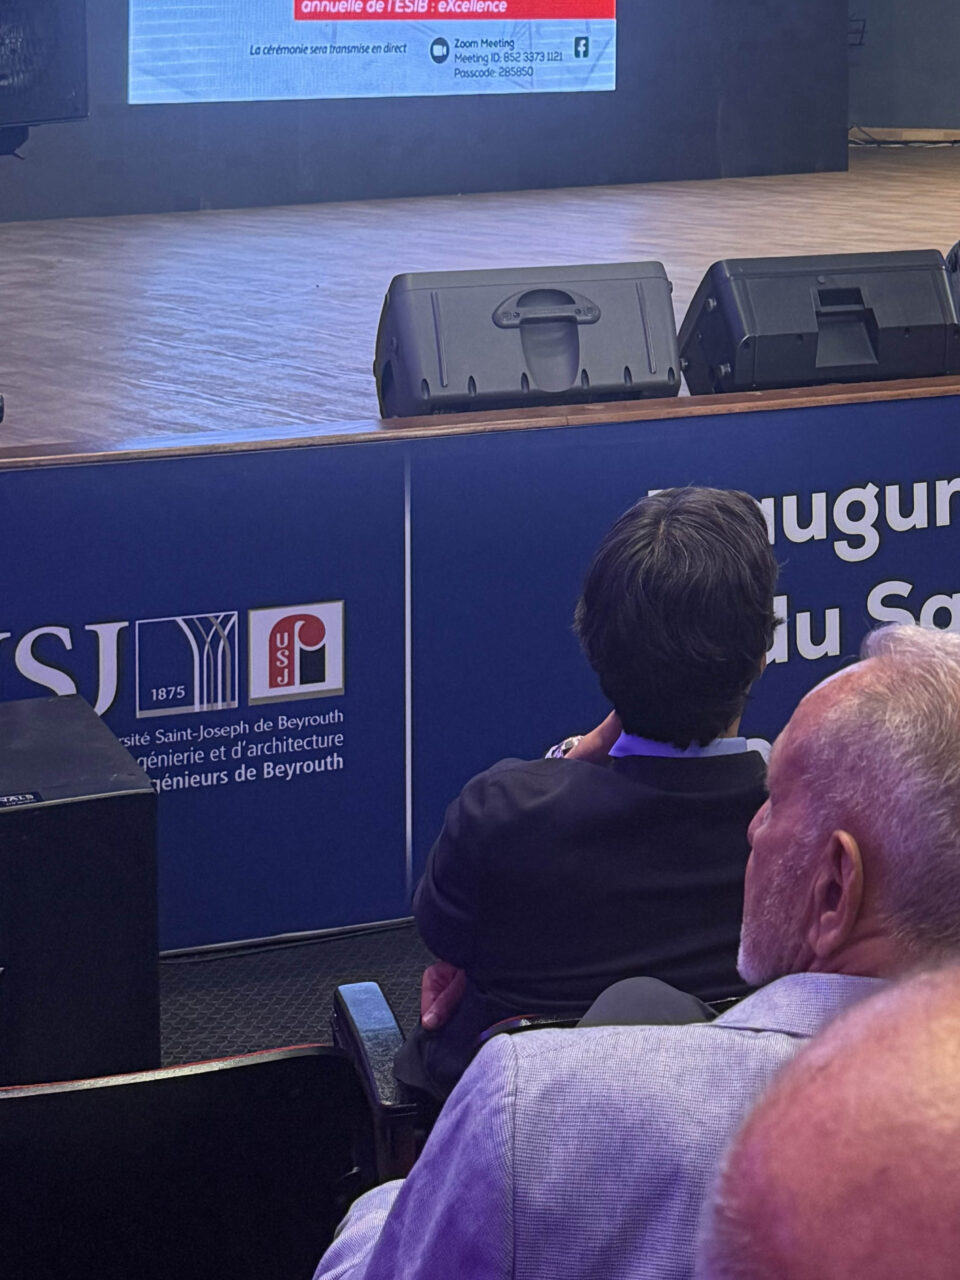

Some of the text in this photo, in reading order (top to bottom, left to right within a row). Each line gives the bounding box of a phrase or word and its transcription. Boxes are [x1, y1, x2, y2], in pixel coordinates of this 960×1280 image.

[250, 42, 408, 56] La cérémonie sera transmise en direct
[454, 38, 515, 51] Zoom Meeting
[454, 50, 563, 66] Meeting ID: 852 3373 1121
[454, 67, 497, 78] Passcode:
[0, 621, 129, 717] SJ
[150, 684, 186, 702] 1875
[155, 721, 250, 745] Saint-Joseph
[254, 718, 274, 733] de
[278, 709, 344, 731] Beyrouth
[137, 733, 344, 772] génierie et d'architecture
[234, 764, 257, 782] de
[263, 753, 344, 781] Beyrouth
